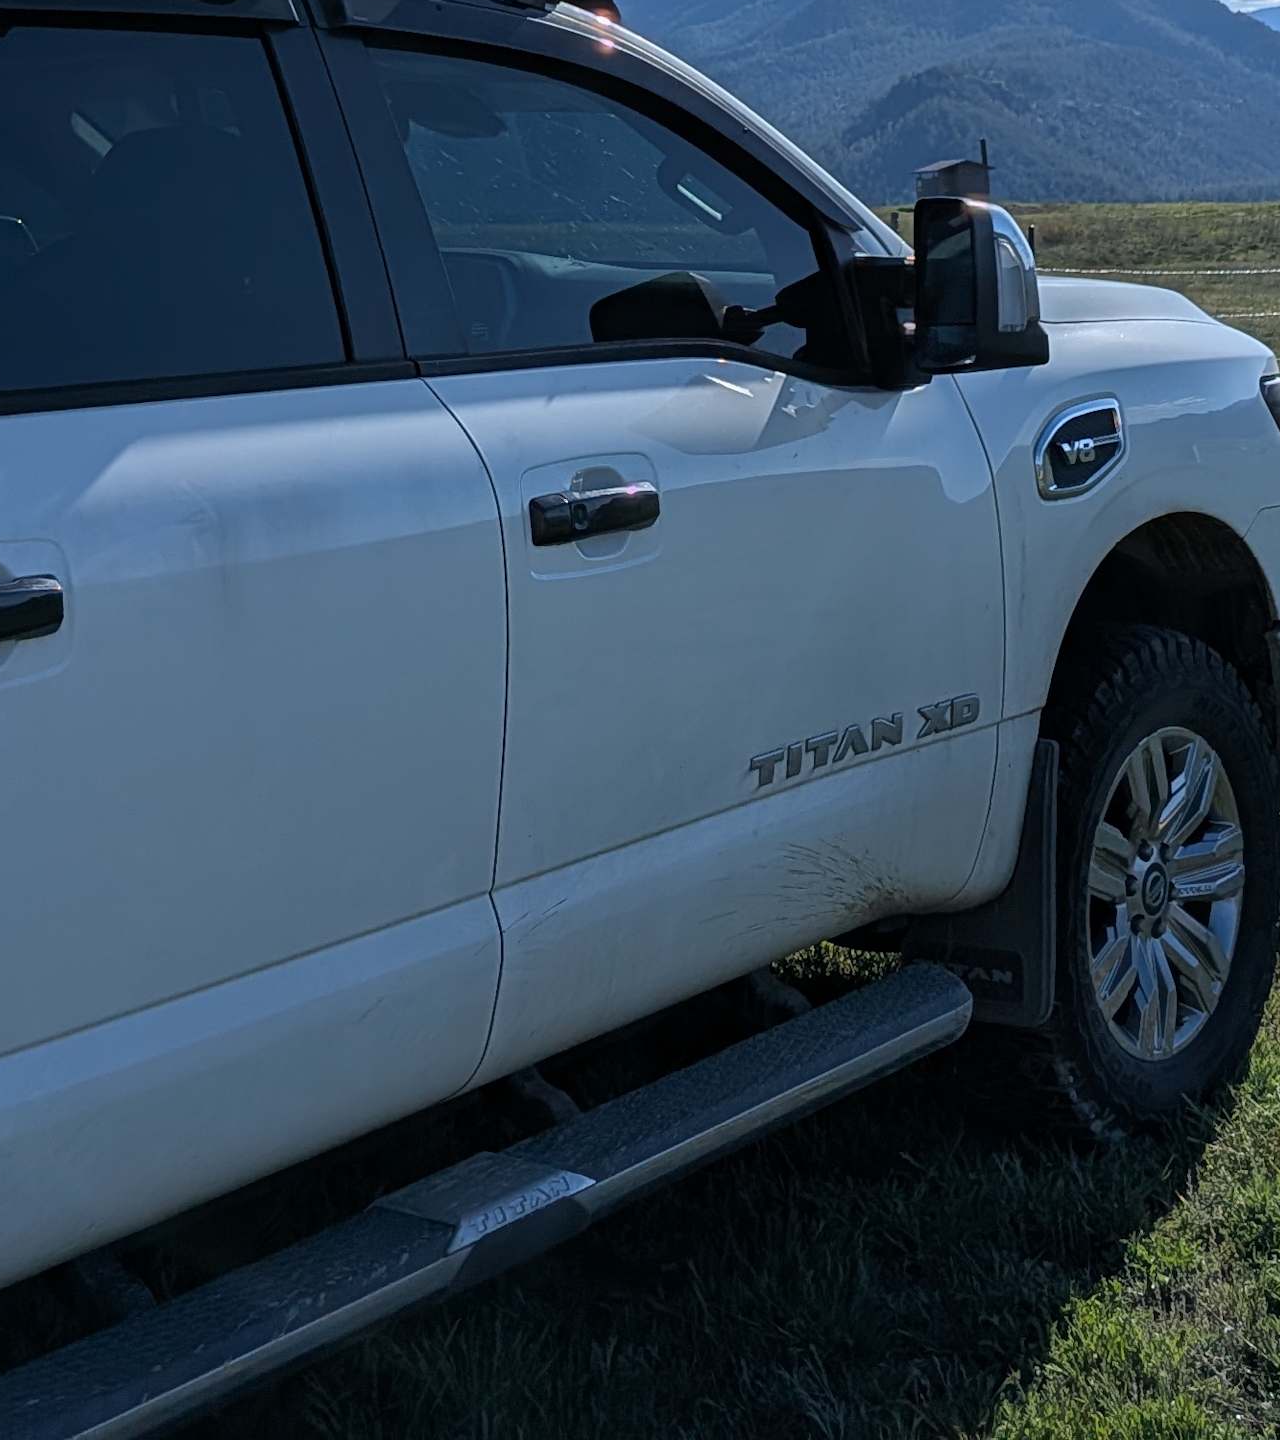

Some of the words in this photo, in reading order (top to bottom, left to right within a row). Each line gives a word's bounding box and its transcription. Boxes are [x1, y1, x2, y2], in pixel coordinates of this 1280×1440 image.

[1059, 438, 1096, 465] V8
[749, 712, 904, 787] TITAN
[917, 692, 980, 739] XD
[946, 962, 1014, 985] TAN
[469, 1175, 570, 1233] TITAN
